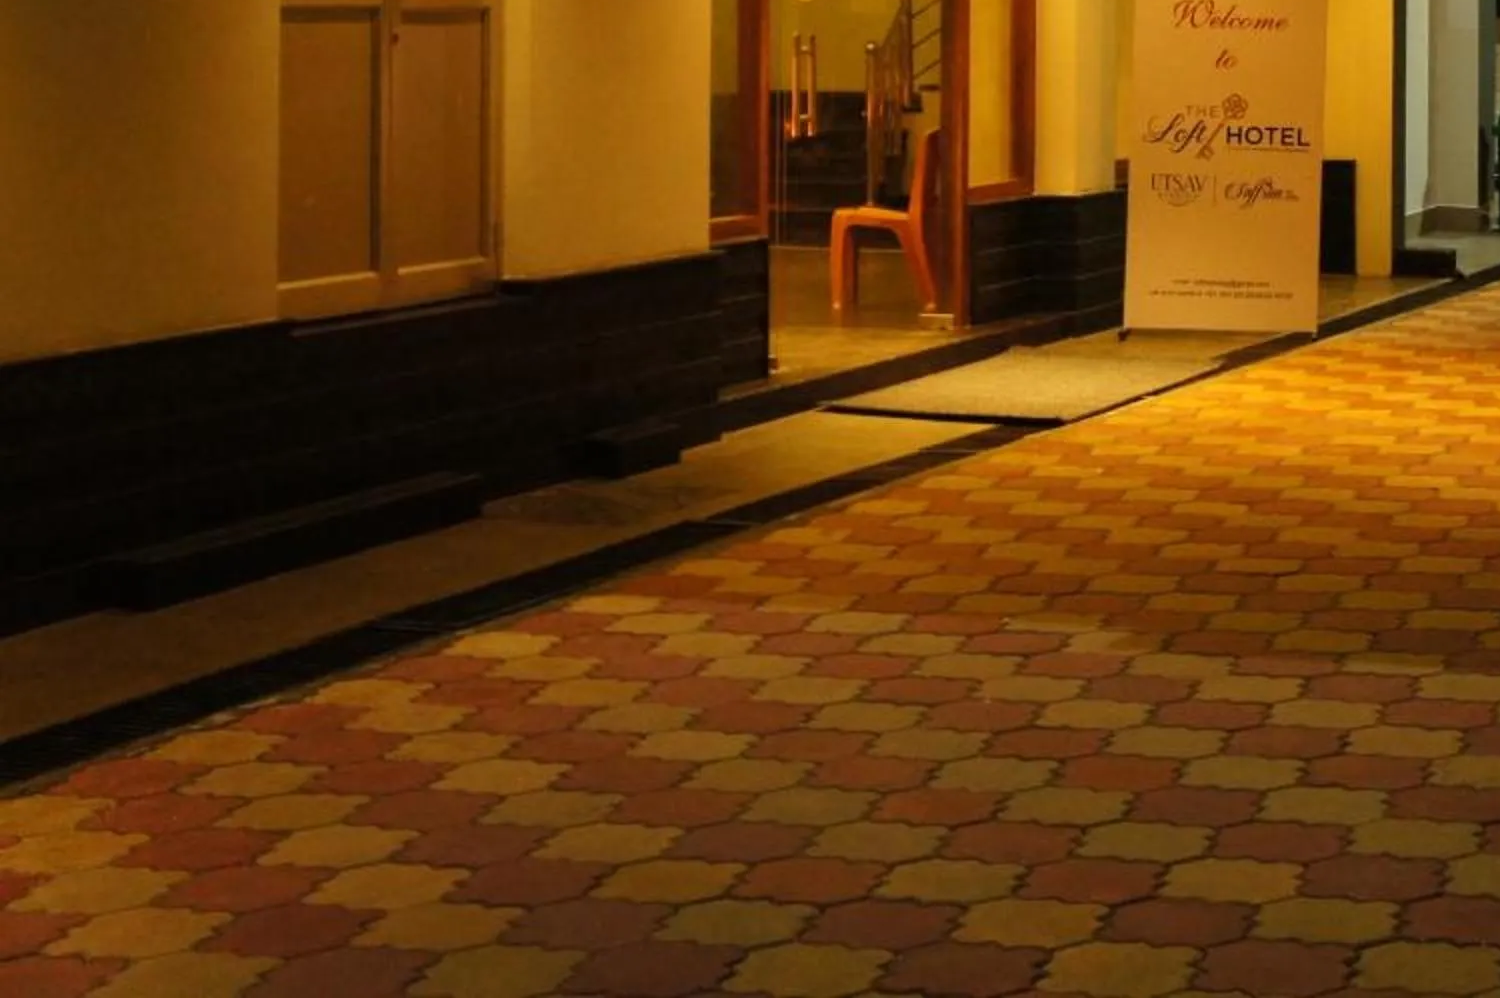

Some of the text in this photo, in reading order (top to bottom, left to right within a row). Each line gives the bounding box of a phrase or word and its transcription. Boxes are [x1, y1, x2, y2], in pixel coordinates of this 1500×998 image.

[1215, 49, 1239, 71] to
[1186, 104, 1222, 120] THE
[1225, 124, 1312, 148] HOTEL
